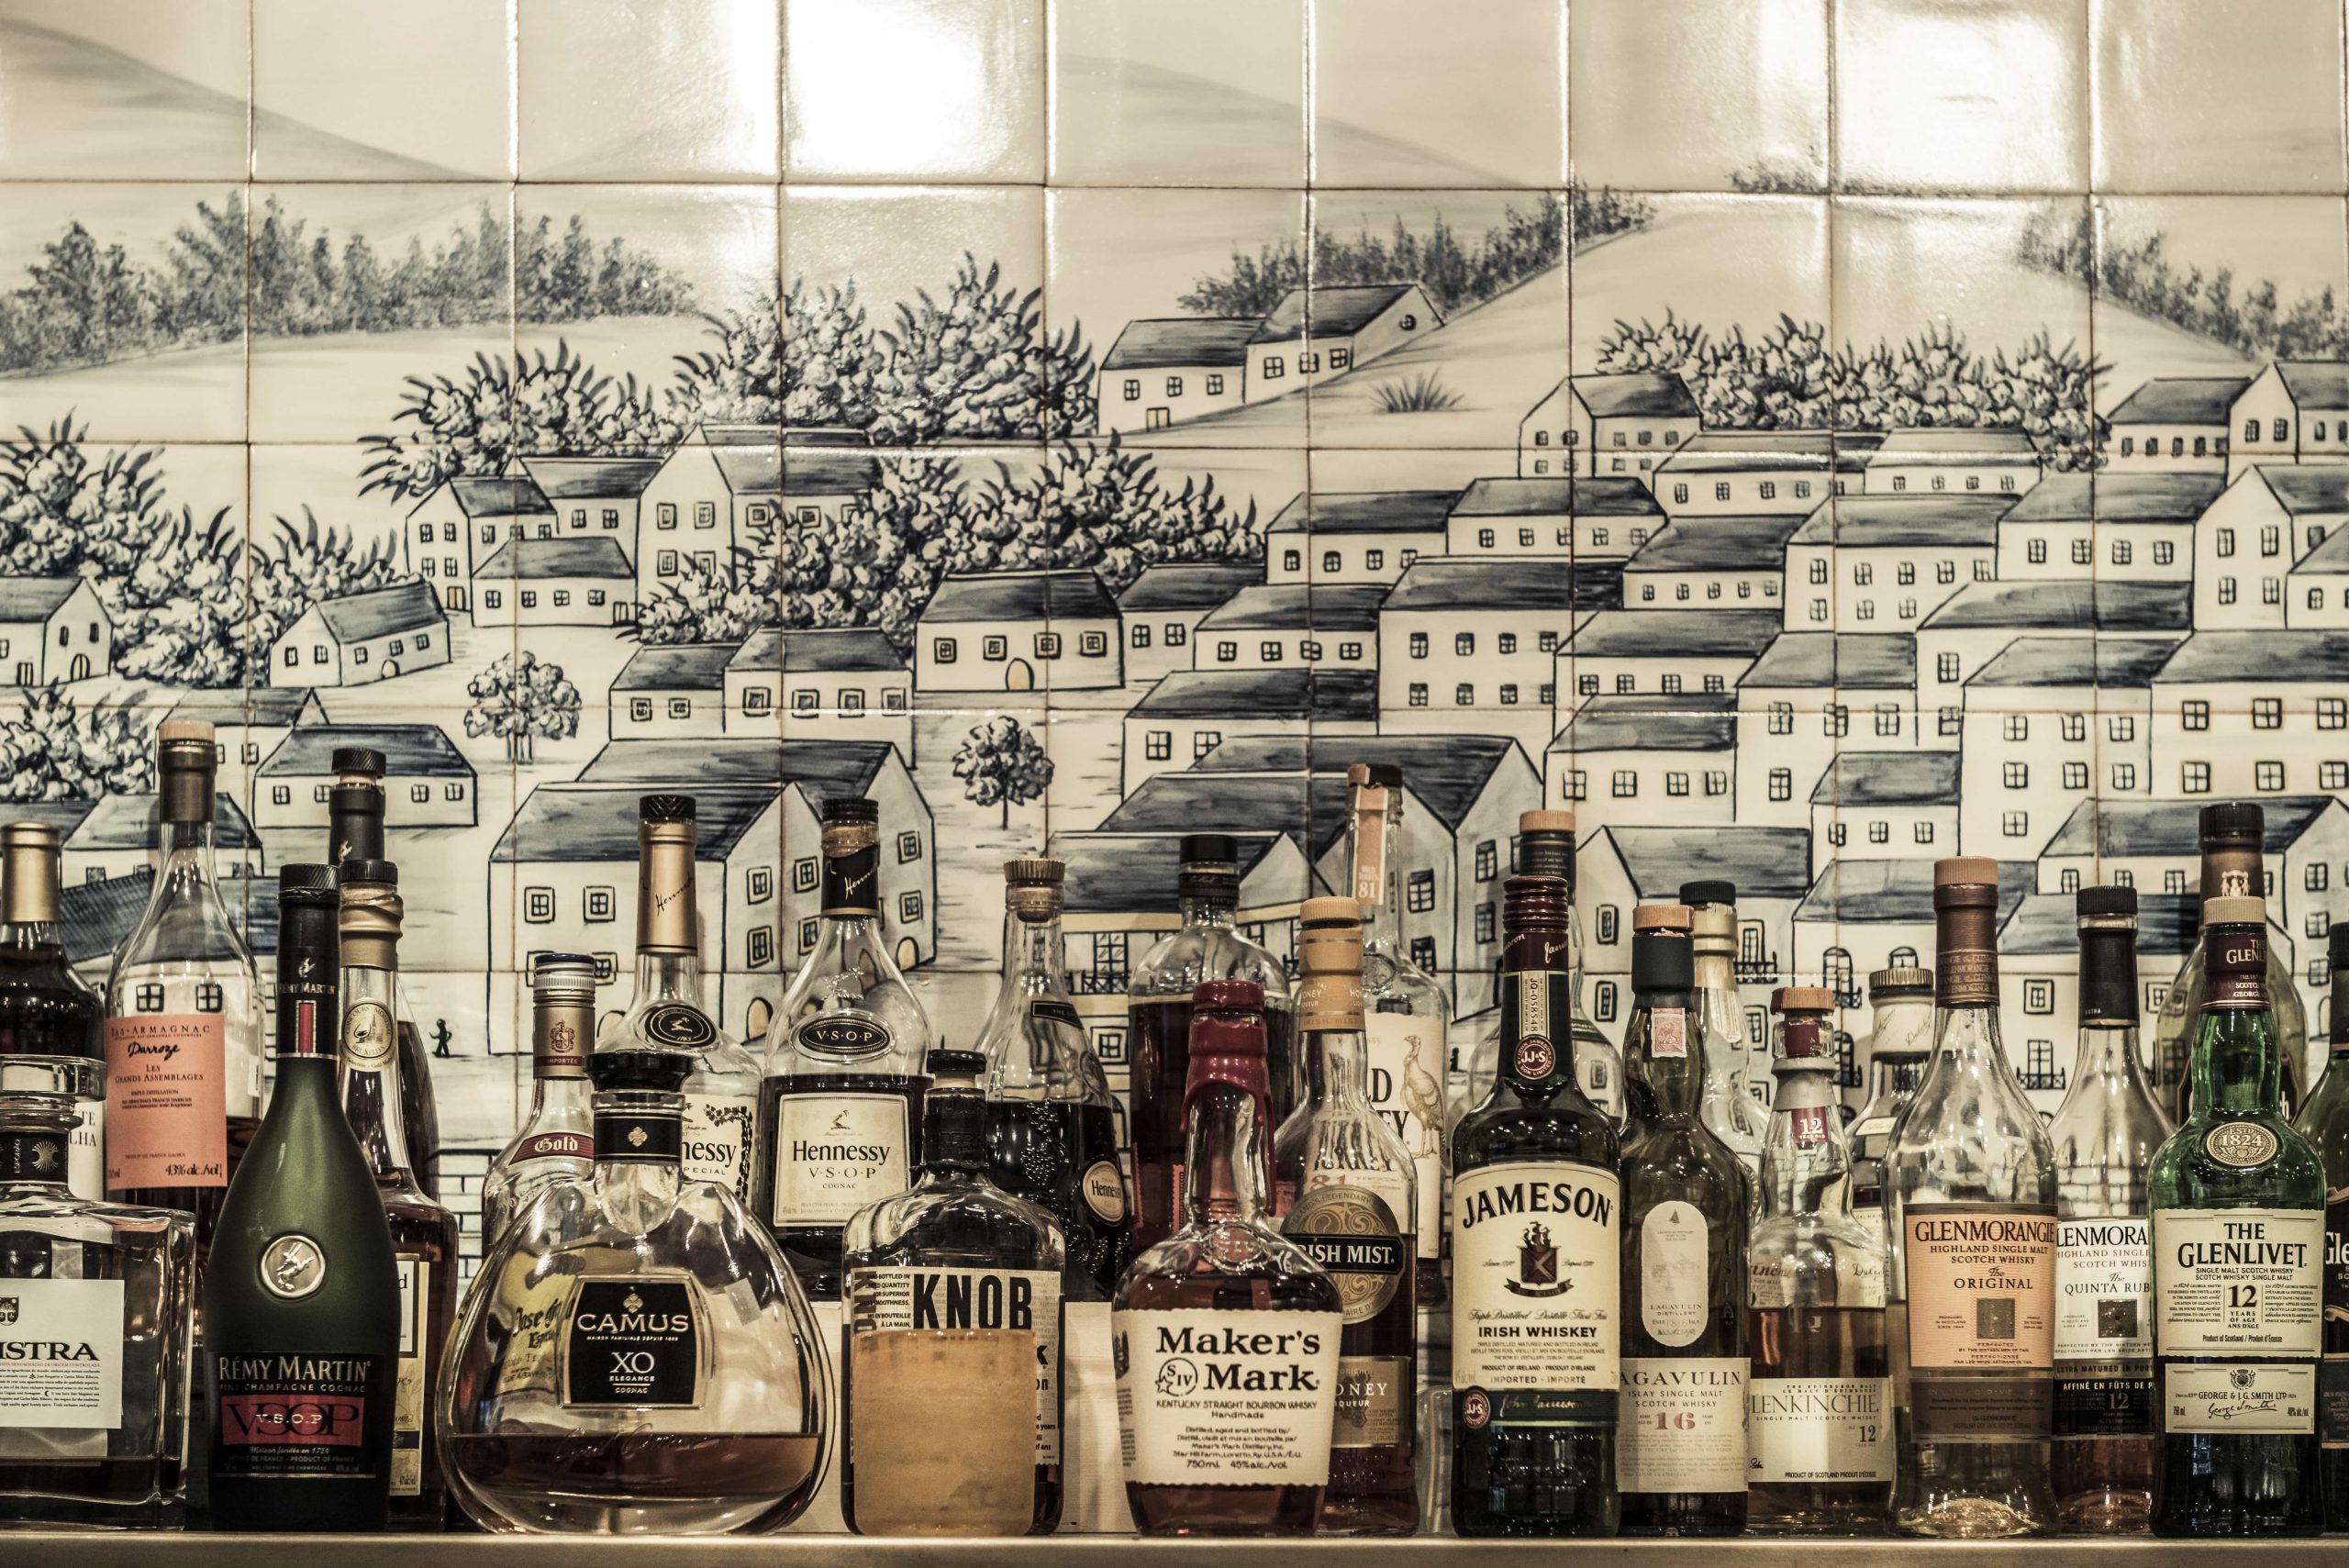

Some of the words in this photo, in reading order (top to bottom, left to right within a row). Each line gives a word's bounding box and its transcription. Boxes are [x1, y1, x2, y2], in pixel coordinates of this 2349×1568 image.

[1358, 881, 1376, 898] 81
[128, 1040, 181, 1062] Darroze
[146, 1064, 161, 1073] LES
[144, 1073, 204, 1082] ASSEMBLAGES
[1799, 1117, 1823, 1135] 12
[534, 1136, 579, 1152] Gold
[2221, 1134, 2264, 1147] 1824
[793, 1140, 891, 1166] Hennessy
[1463, 1182, 1611, 1229] JAMESON
[1915, 1220, 2055, 1243] GLENMORANGIE
[2223, 1223, 2265, 1240] THE
[1930, 1245, 1989, 1253] HIGHLAND
[1992, 1245, 2027, 1253] SINGLE
[2030, 1246, 2048, 1254] MALT
[2177, 1242, 2305, 1268] GLENLIVET
[1951, 1255, 1996, 1263] SCOTCH
[1999, 1256, 2035, 1264] WHISKY
[2074, 1260, 2117, 1268] SCOTCH
[1988, 1266, 2005, 1277] The
[2110, 1272, 2125, 1283] The
[1954, 1278, 2033, 1289] ORIGINAL
[2065, 1283, 2118, 1296] QUINTA
[913, 1273, 1032, 1330] KNOB
[2228, 1284, 2258, 1308] 12
[577, 1313, 689, 1333] CAMUS
[1478, 1327, 1520, 1338] IRISH
[1526, 1327, 1598, 1338] WHISKEY
[2202, 1334, 2219, 1342] Product
[2220, 1334, 2225, 1342] of
[2225, 1334, 2244, 1342] Scotland
[2248, 1334, 2264, 1342] Produit
[1155, 1327, 1320, 1355] Maker's
[219, 1355, 273, 1381] RÉMY
[278, 1356, 367, 1382] MARTIN
[610, 1351, 655, 1373] XO
[1203, 1363, 1317, 1392] Mark
[1547, 1375, 1586, 1385] IMPORTÉ
[1620, 1372, 1741, 1385] AGAVULIN
[2063, 1381, 2090, 1391] AFFINÉ
[2094, 1382, 2105, 1390] EN
[2109, 1380, 2131, 1390] FÛTS
[320, 1384, 366, 1393] COGNAC
[2199, 1391, 2228, 1400] GEORGE
[2230, 1392, 2236, 1400] &
[2251, 1392, 2274, 1400] SMITH
[1156, 1400, 1201, 1408] KENTUCKY
[1203, 1401, 1244, 1409] STRAIGHT
[1288, 1402, 1318, 1410] WHISKY
[2110, 1393, 2130, 1409] 12
[1211, 1411, 1264, 1419] Handmade
[2208, 1403, 2235, 1419] George
[1654, 1411, 1696, 1430] 16
[1859, 1424, 1876, 1442] 12
